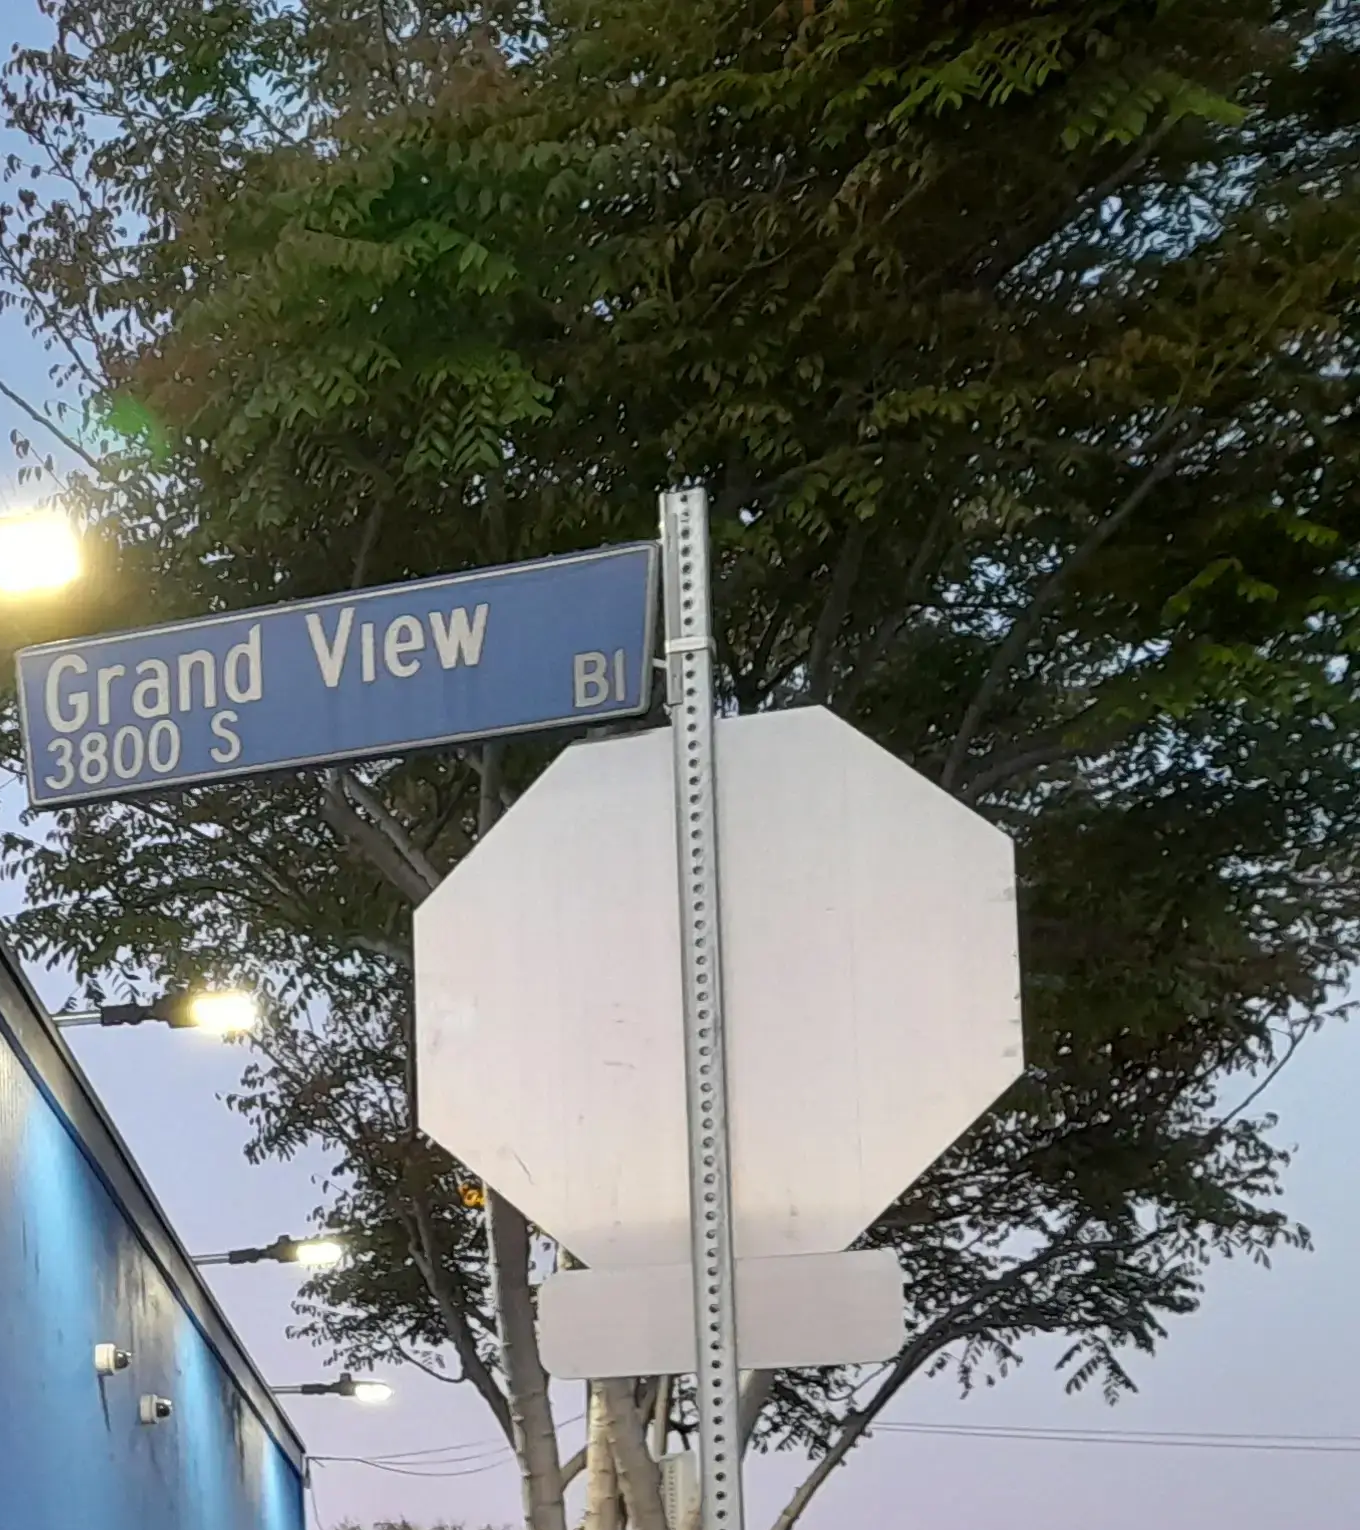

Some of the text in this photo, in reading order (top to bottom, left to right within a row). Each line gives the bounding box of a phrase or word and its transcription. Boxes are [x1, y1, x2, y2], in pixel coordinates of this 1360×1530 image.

[43, 602, 626, 733] Grand View Bl
[43, 709, 242, 791] 3800 S
